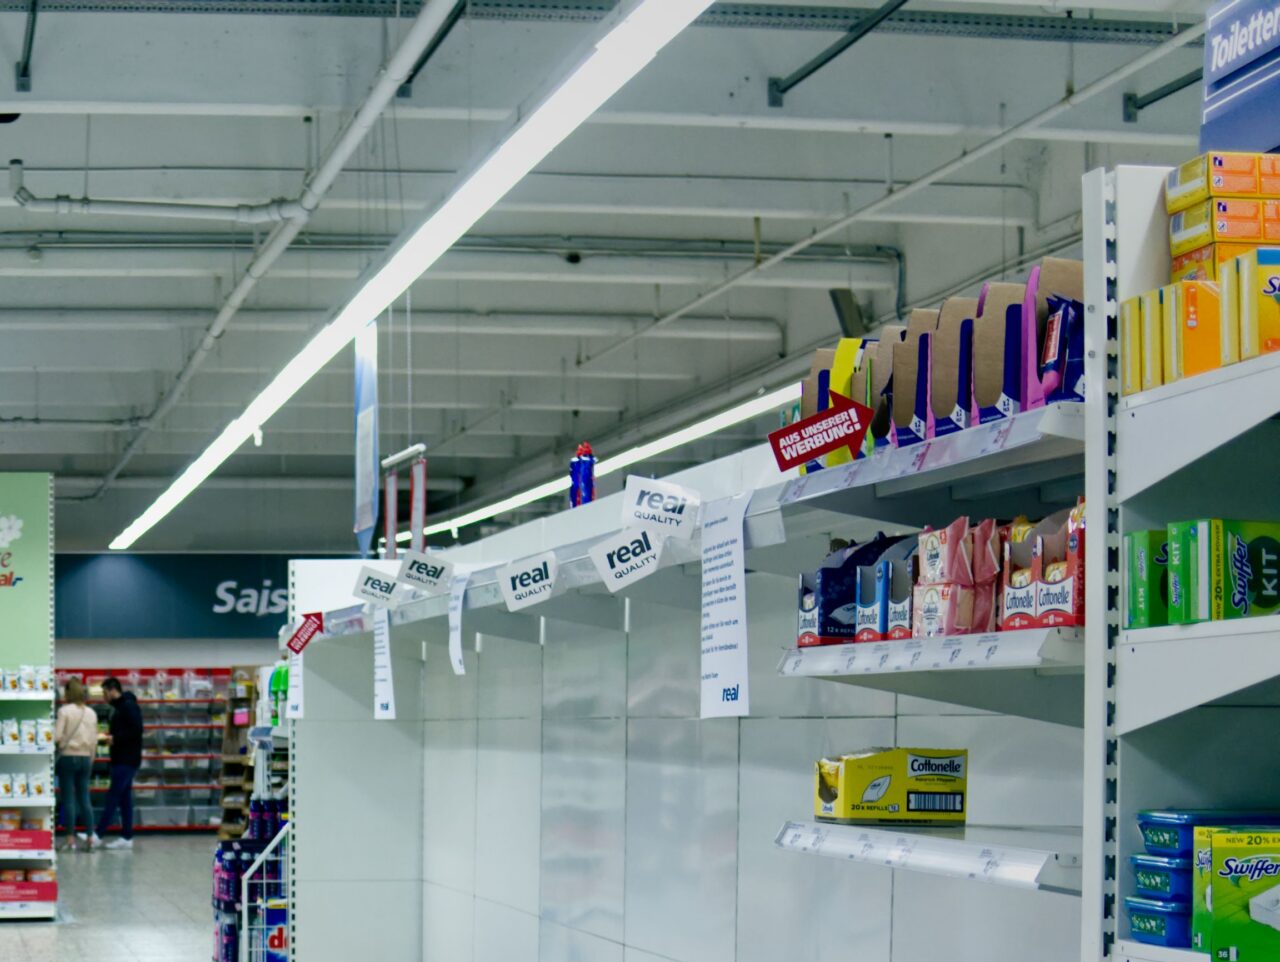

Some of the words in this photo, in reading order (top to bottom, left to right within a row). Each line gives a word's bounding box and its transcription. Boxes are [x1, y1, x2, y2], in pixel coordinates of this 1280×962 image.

[779, 432, 801, 450] AUS
[801, 411, 849, 439] UNSERER
[781, 408, 862, 461] WERBUNG!
[634, 510, 682, 527] QUALITY
[606, 530, 652, 569] real
[1172, 541, 1180, 565] KIT
[408, 559, 445, 580] real
[510, 561, 550, 591] real
[614, 553, 657, 579] QUALITY
[1232, 535, 1253, 616] Swiffer
[1262, 548, 1278, 596] KIT
[363, 575, 397, 595] real
[405, 573, 438, 586] QUALITY
[360, 588, 390, 602] QUALITY
[514, 583, 553, 601] QUALITY
[1006, 590, 1034, 611] Cottonelle
[1038, 585, 1070, 607] Cottonelle
[722, 683, 740, 702] real
[910, 758, 961, 774] Cottonelle
[1246, 835, 1270, 846] 20%
[1219, 858, 1280, 881] Swiffer
